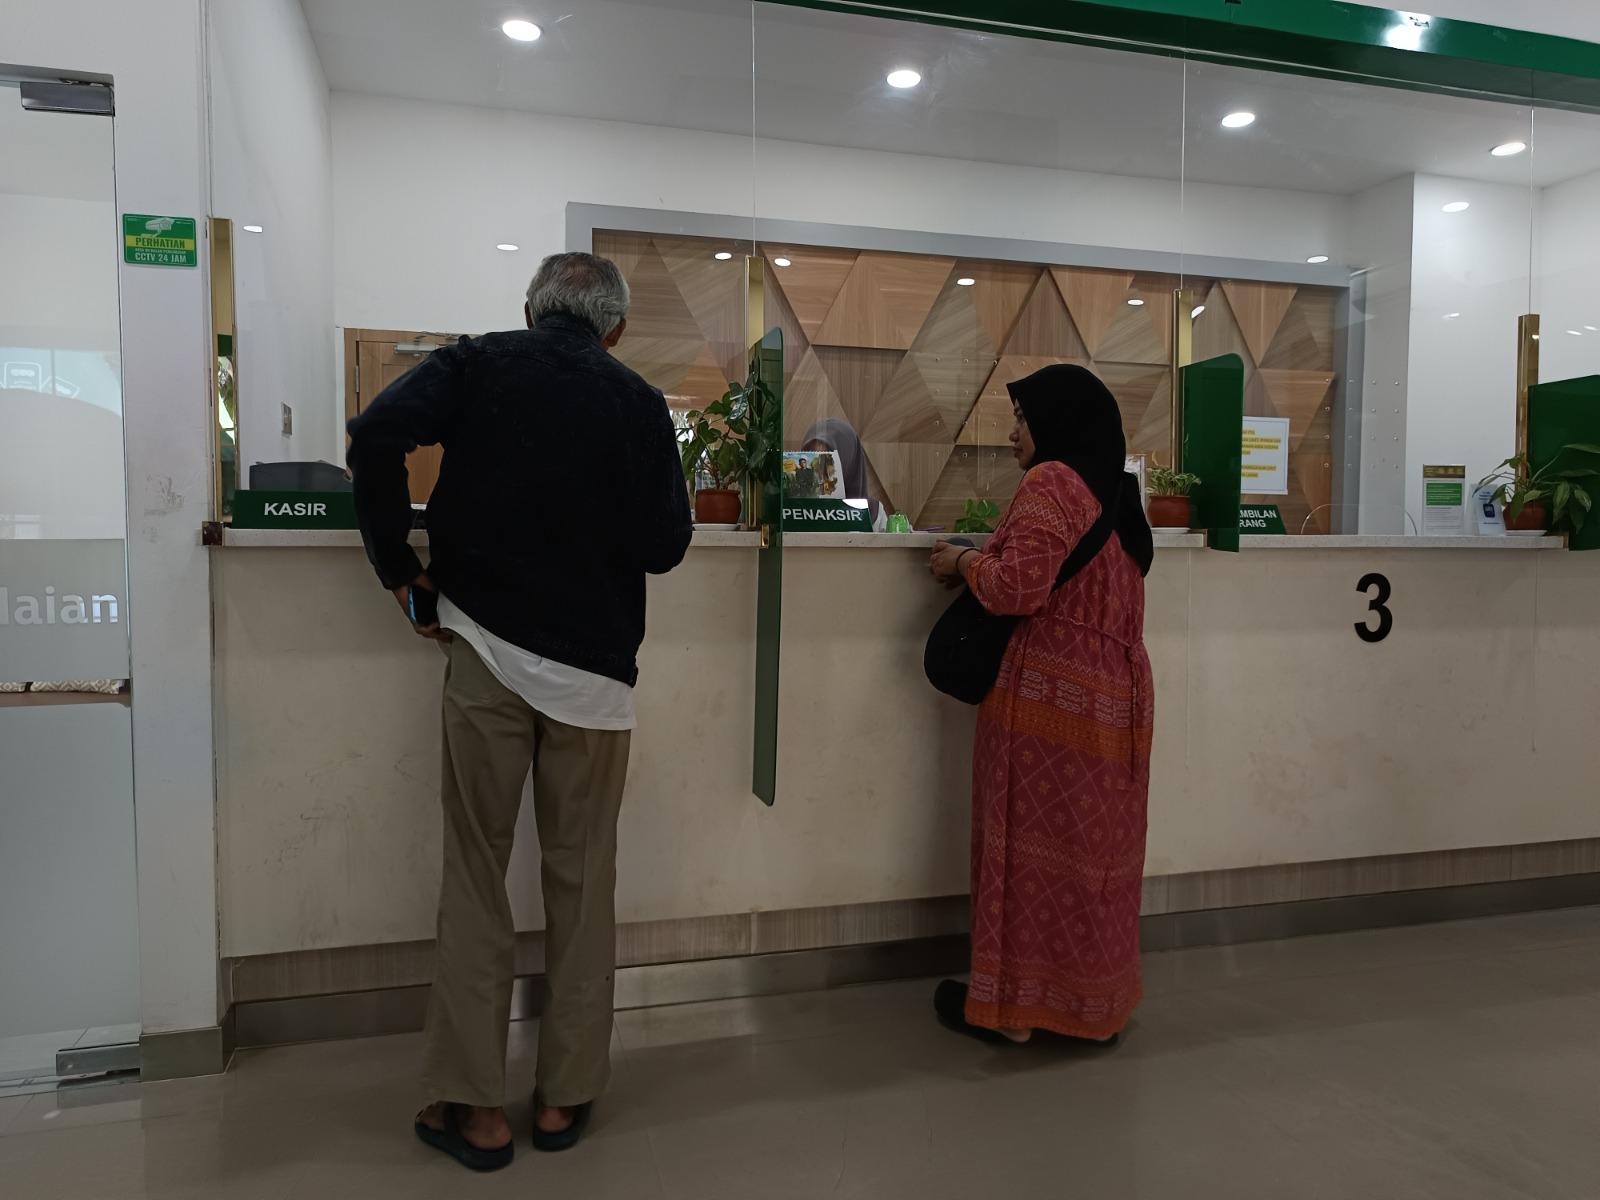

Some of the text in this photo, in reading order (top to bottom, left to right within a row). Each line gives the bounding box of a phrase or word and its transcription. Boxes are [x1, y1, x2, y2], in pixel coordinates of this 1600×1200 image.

[135, 237, 185, 249] PERHATIAN
[135, 252, 186, 263] CCTV 24 JAM
[264, 502, 327, 516] KASIR
[782, 508, 862, 521] PENAKSIR
[1239, 509, 1277, 519] MBILAN
[1239, 519, 1266, 528] RANG
[0, 586, 118, 625] laian
[1354, 572, 1393, 643] 3
